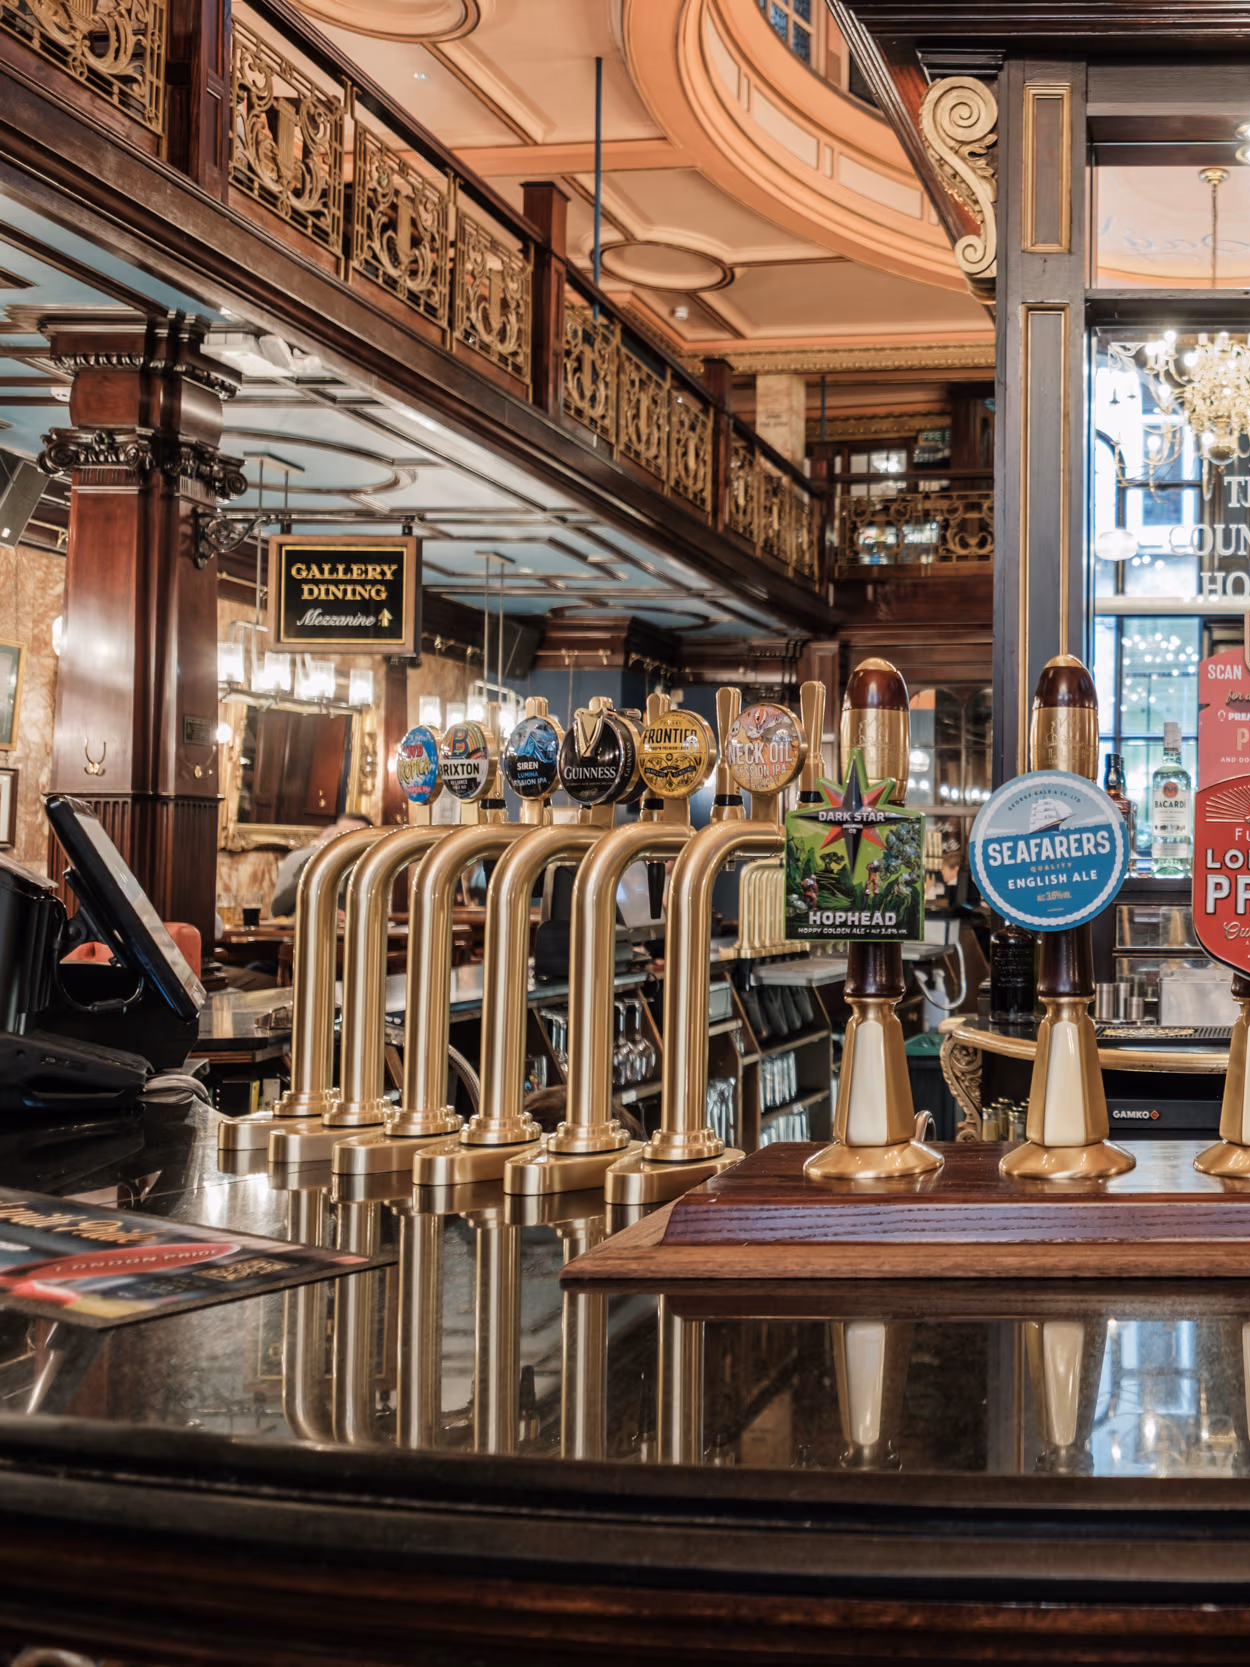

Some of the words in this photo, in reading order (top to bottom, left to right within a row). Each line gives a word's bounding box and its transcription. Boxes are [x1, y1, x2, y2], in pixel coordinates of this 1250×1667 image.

[291, 563, 398, 580] GALLERY
[301, 583, 388, 600] DINING
[296, 608, 376, 626] Mezzanine
[1207, 664, 1242, 680] SCAN
[1226, 689, 1243, 704] for
[728, 742, 765, 764] NECK
[440, 763, 480, 776] BRIXTON
[517, 761, 539, 771] SIREN
[564, 766, 616, 780] GUINNESS
[735, 764, 769, 778] SESSION
[773, 763, 787, 775] IPA
[1008, 794, 1032, 811] GEORGE
[1154, 801, 1186, 809] BACARDI
[818, 811, 852, 822] DARK
[854, 812, 885, 822] STAR
[987, 831, 1111, 867] SEAFARERS
[1030, 862, 1073, 872] QUALITY
[1008, 873, 1067, 889] ENGLISH
[1072, 870, 1098, 882] ALE
[809, 911, 897, 926] HOPHEAD
[1112, 1110, 1149, 1119] GAMKO
